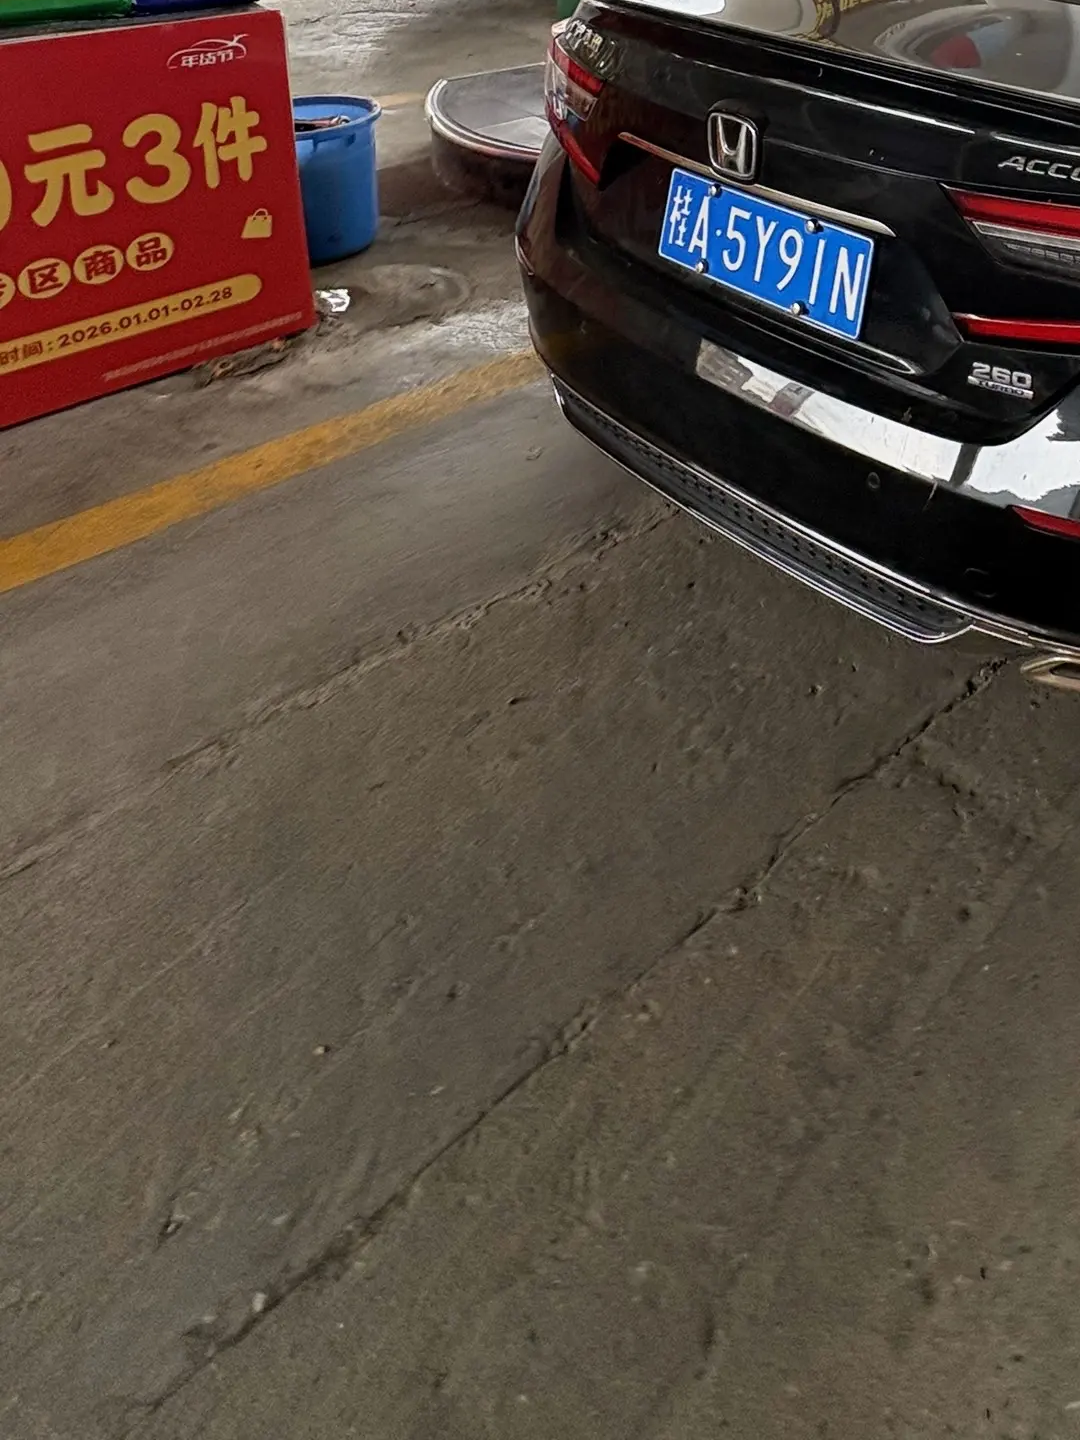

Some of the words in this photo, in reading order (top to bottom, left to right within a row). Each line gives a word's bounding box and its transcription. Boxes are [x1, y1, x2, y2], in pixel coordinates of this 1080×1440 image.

[181, 49, 234, 68] 年货节
[0, 95, 268, 232] 元3件
[0, 236, 168, 299] 区商品
[972, 362, 1032, 389] 260
